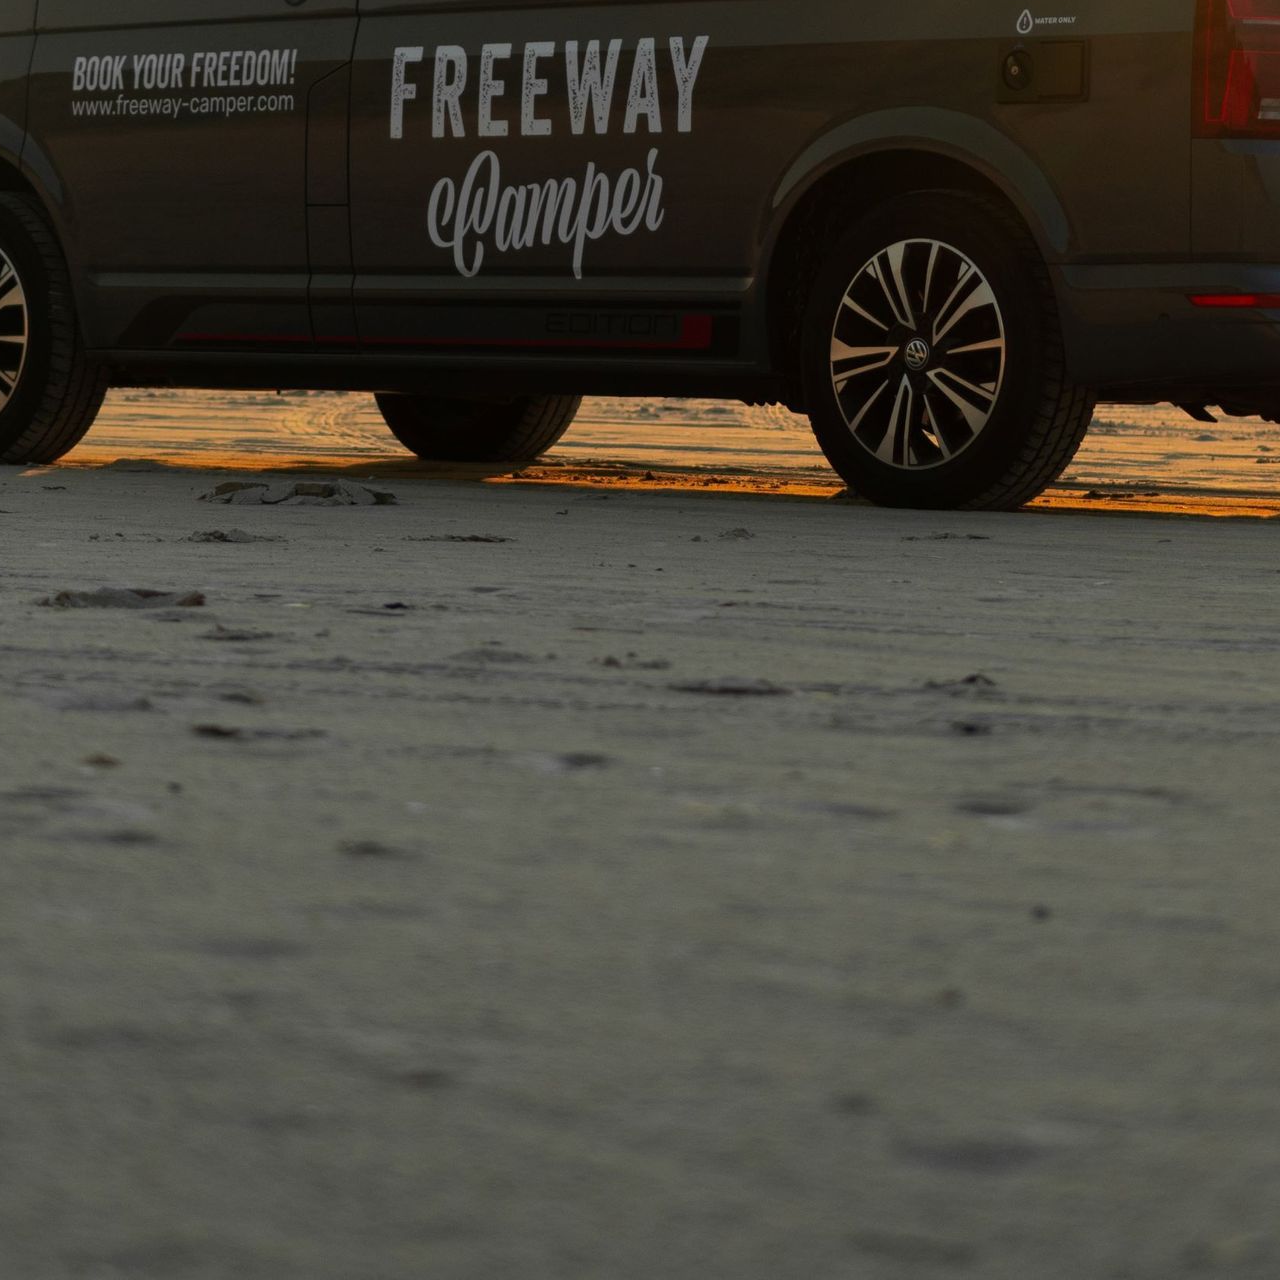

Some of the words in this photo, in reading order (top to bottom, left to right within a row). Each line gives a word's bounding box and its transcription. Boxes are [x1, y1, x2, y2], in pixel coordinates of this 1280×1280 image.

[1058, 16, 1077, 24] ONLY
[72, 55, 127, 91] BOOK
[133, 53, 185, 89] YOUR
[190, 49, 298, 88] FREEDOM!
[389, 35, 710, 139] FREEWAY
[71, 94, 295, 119] www.freeway-camper.com
[427, 148, 664, 279] Camper
[545, 313, 677, 335] EDITION
